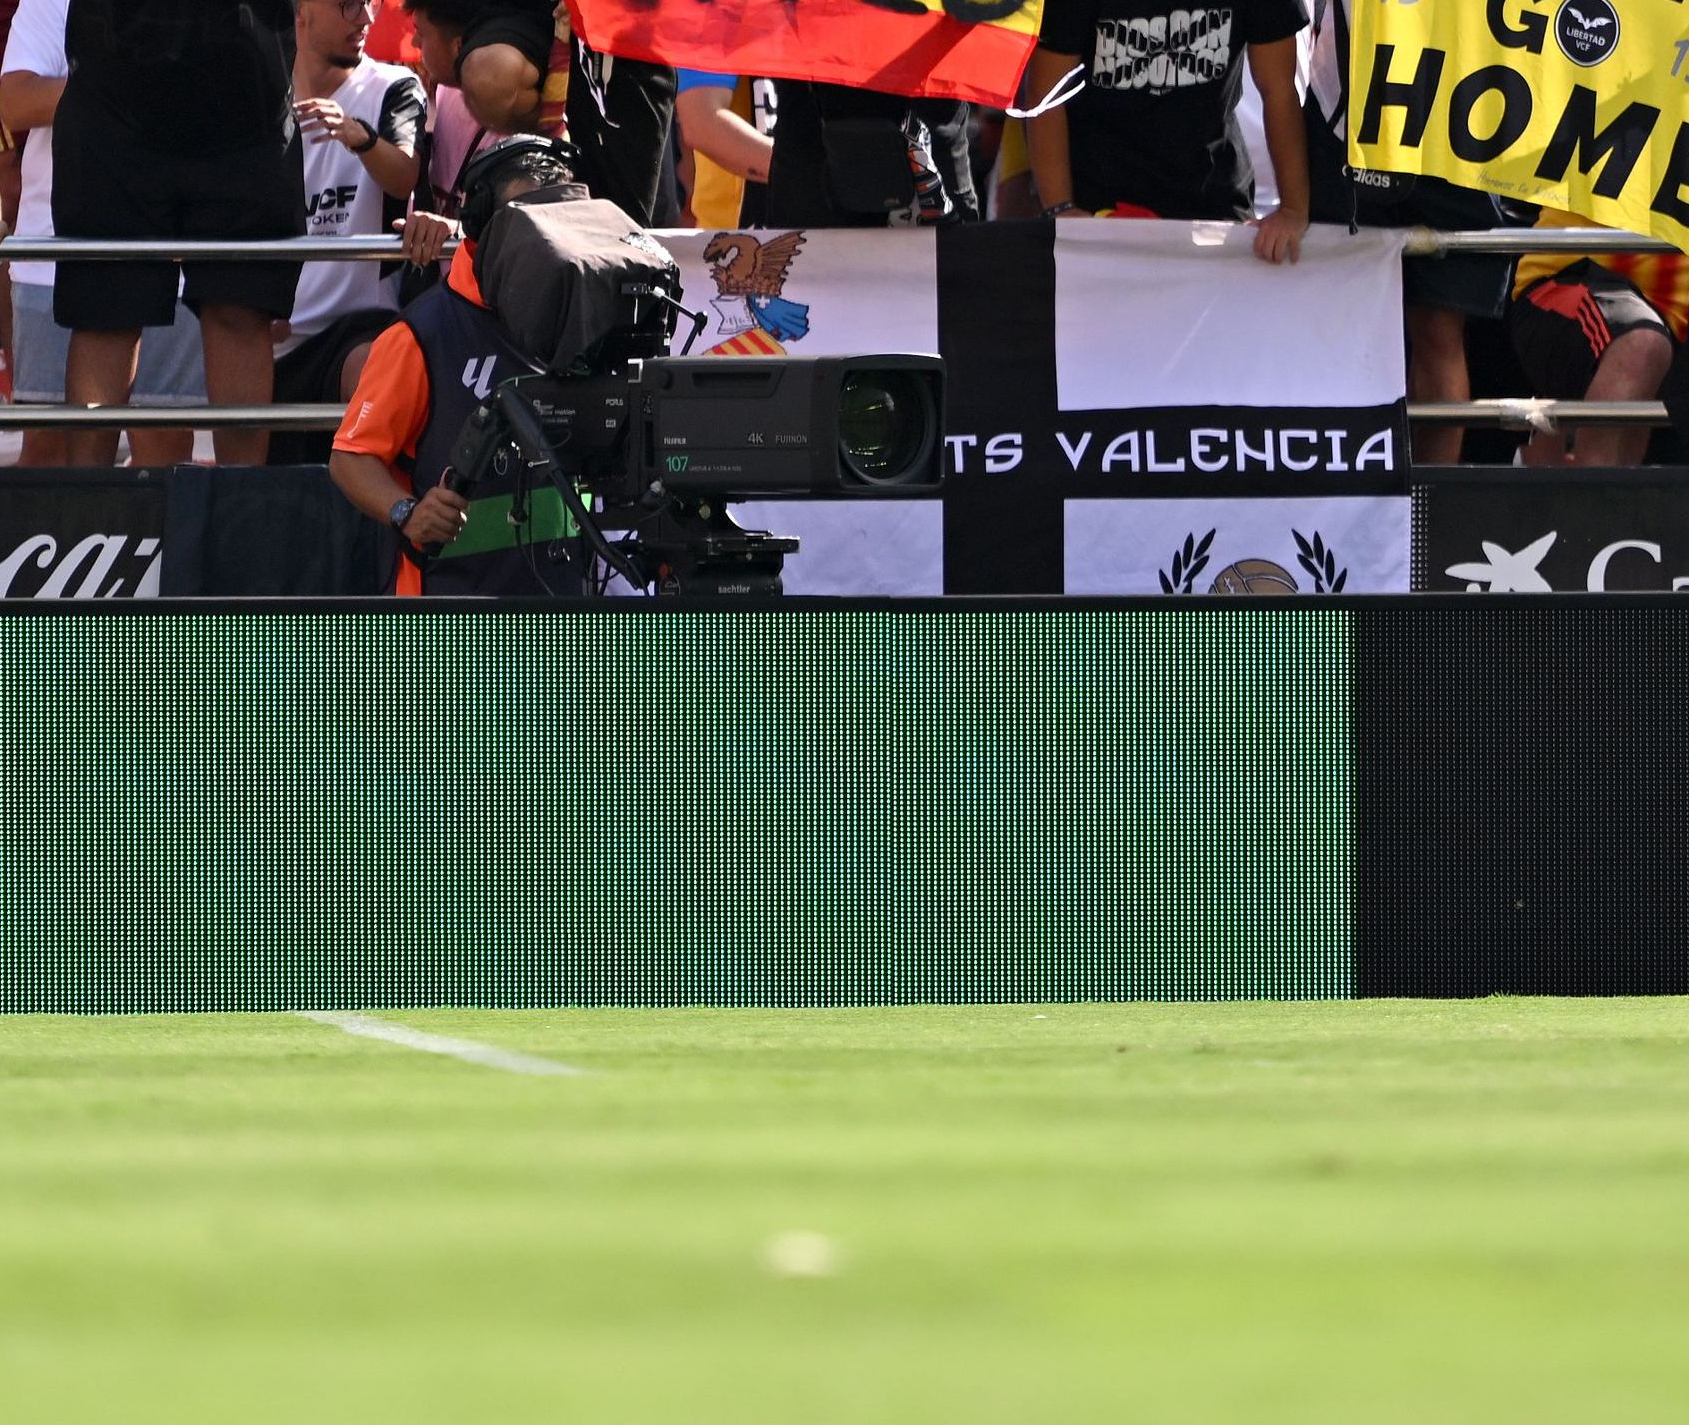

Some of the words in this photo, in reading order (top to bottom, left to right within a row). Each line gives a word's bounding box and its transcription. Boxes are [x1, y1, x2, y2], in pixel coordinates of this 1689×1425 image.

[1565, 26, 1606, 47] LIBERTAD
[1574, 39, 1592, 53] VCF
[747, 433, 764, 445] 4K
[775, 434, 808, 445] FUJINON
[1055, 427, 1393, 472] VALENCIA
[665, 456, 689, 473] 107
[718, 583, 751, 594] sachtler
